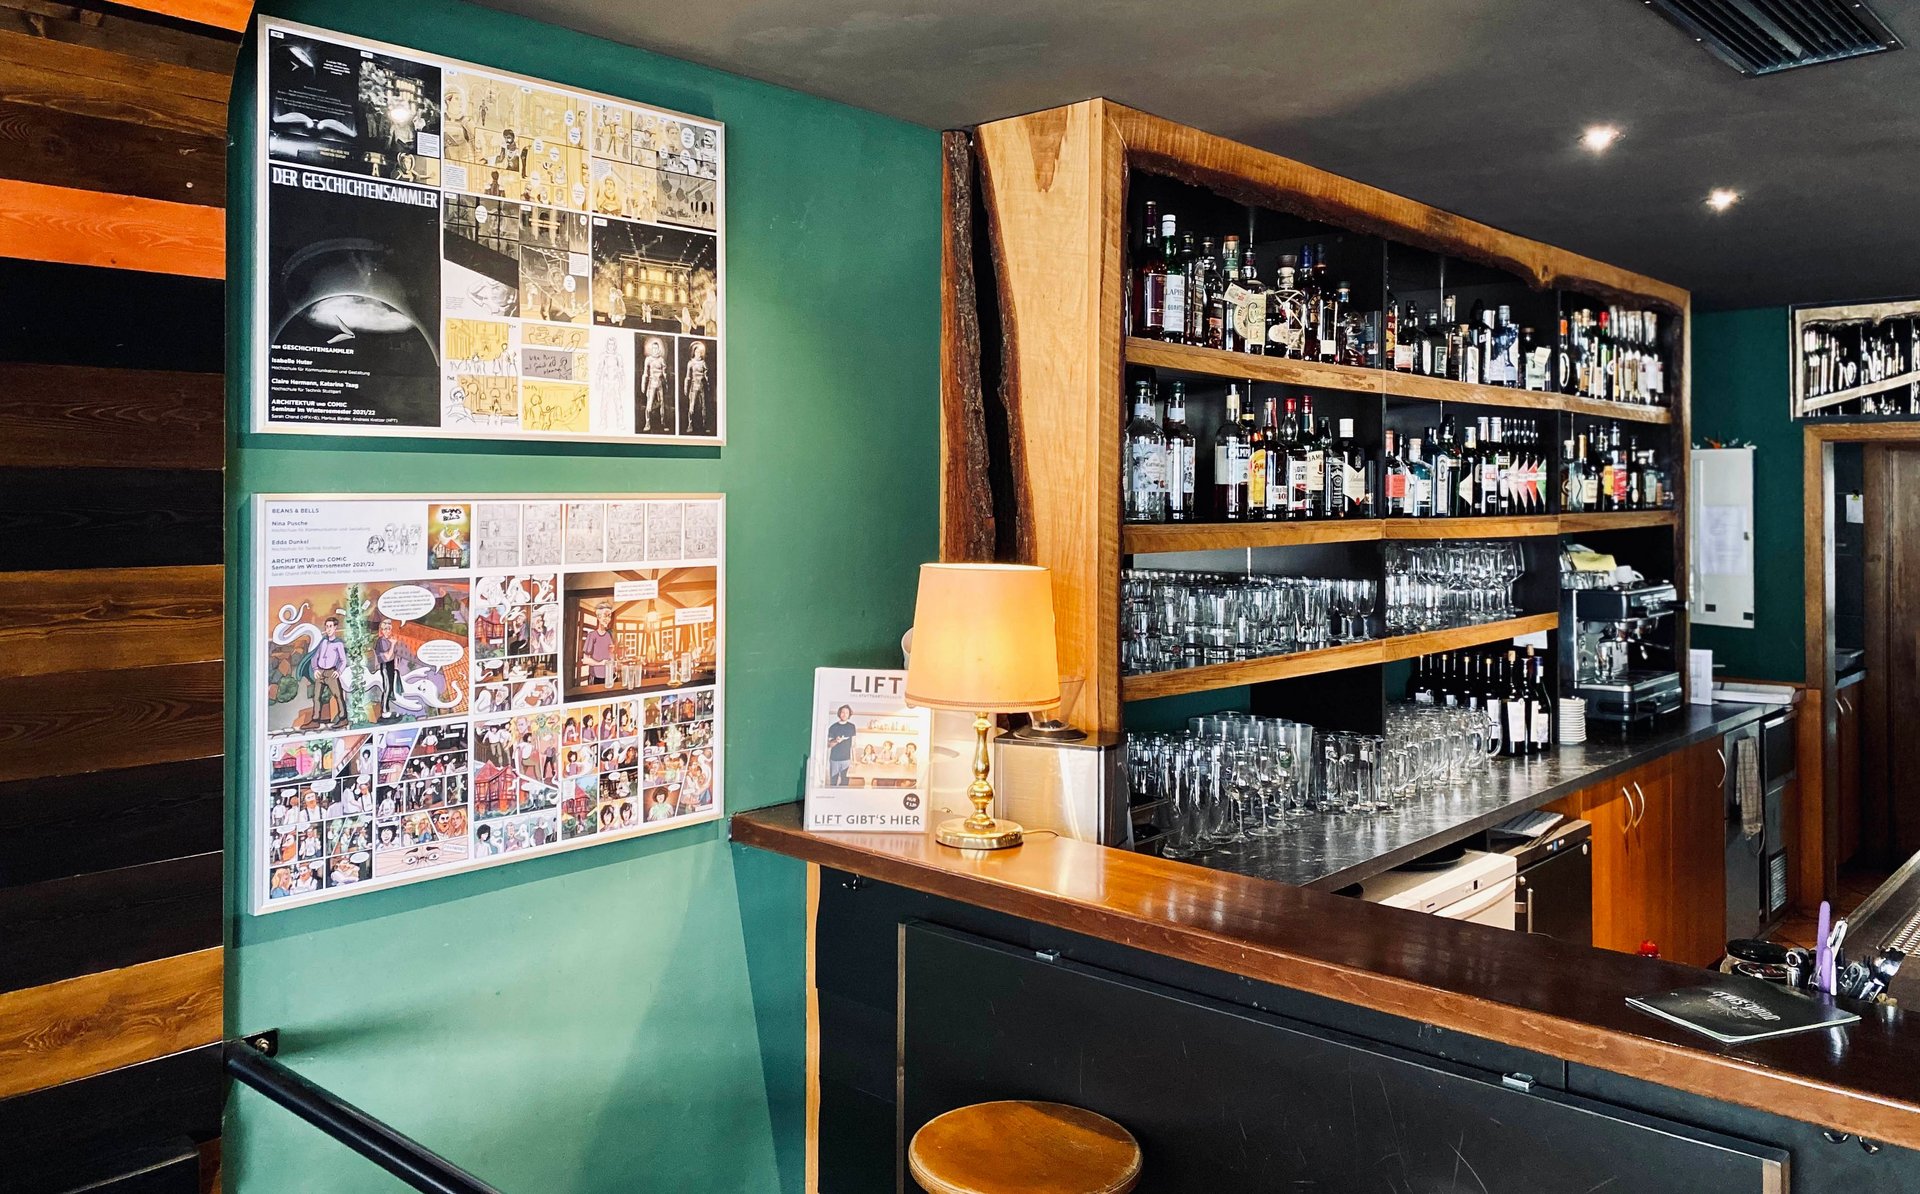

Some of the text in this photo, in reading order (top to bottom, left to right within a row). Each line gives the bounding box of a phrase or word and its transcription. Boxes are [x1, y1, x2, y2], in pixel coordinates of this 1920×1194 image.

[271, 167, 299, 187] DER
[302, 172, 438, 208] GESCHICHTENSAMMLER
[282, 344, 354, 355] GESCHICHTENSAMMLER
[271, 399, 316, 407] ARCHITEKTUR
[306, 407, 352, 415] Wintersemester
[850, 675, 903, 695] LIFT
[814, 814, 921, 825] LIFT GIBT'S HIER
